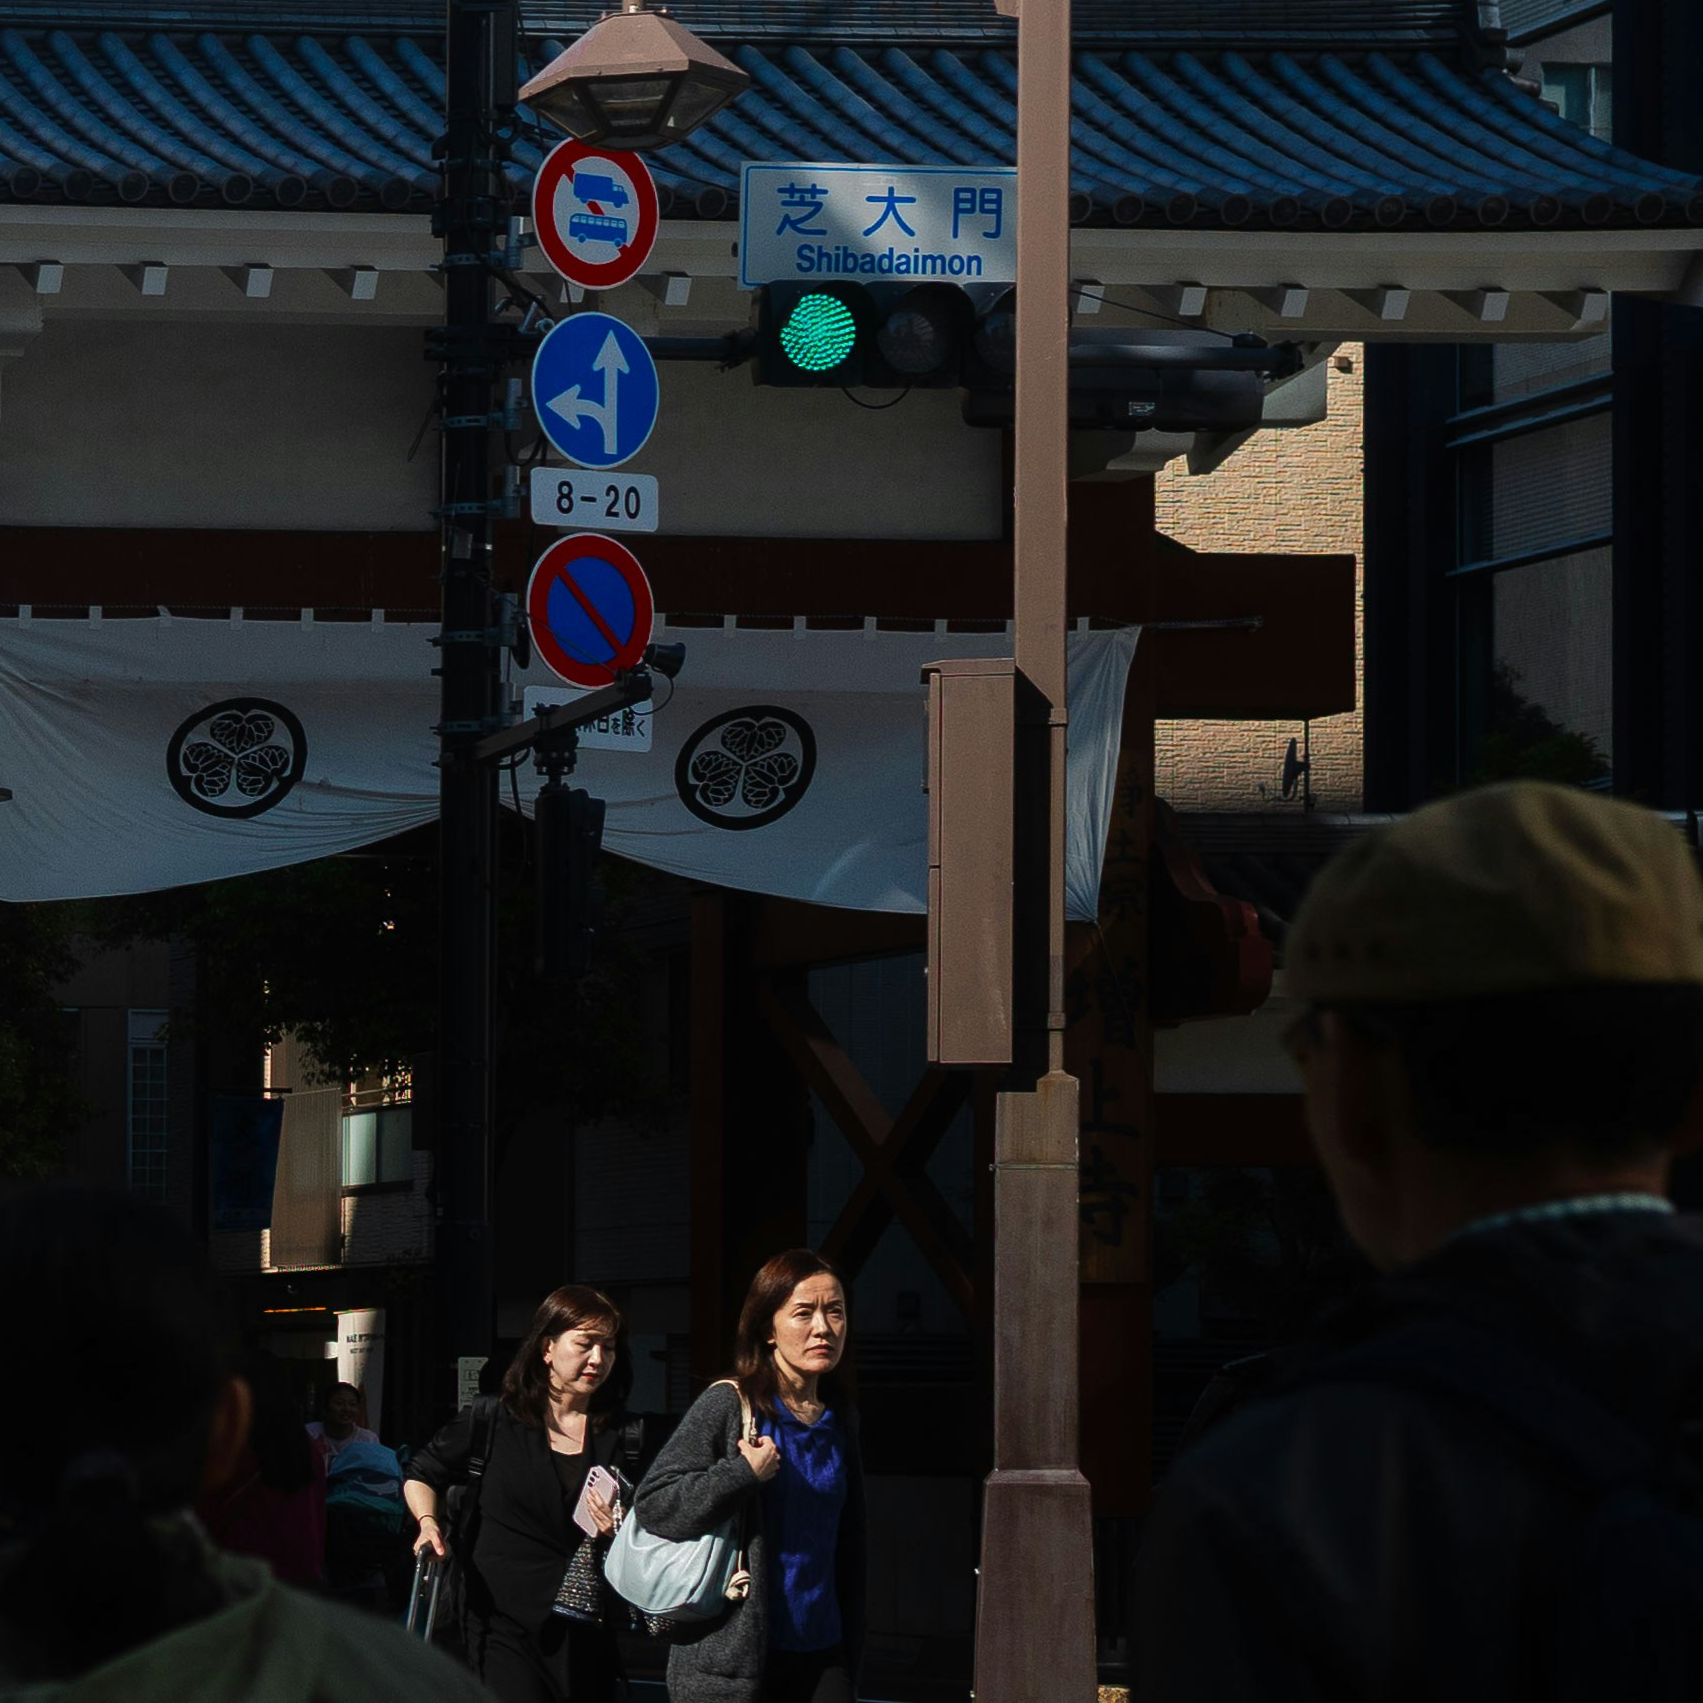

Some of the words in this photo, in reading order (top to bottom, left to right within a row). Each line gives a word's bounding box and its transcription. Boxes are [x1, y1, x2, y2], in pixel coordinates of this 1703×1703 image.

[775, 182, 1003, 240] 芝大門
[795, 243, 983, 277] Shibadaimon
[555, 480, 641, 521] 8-20
